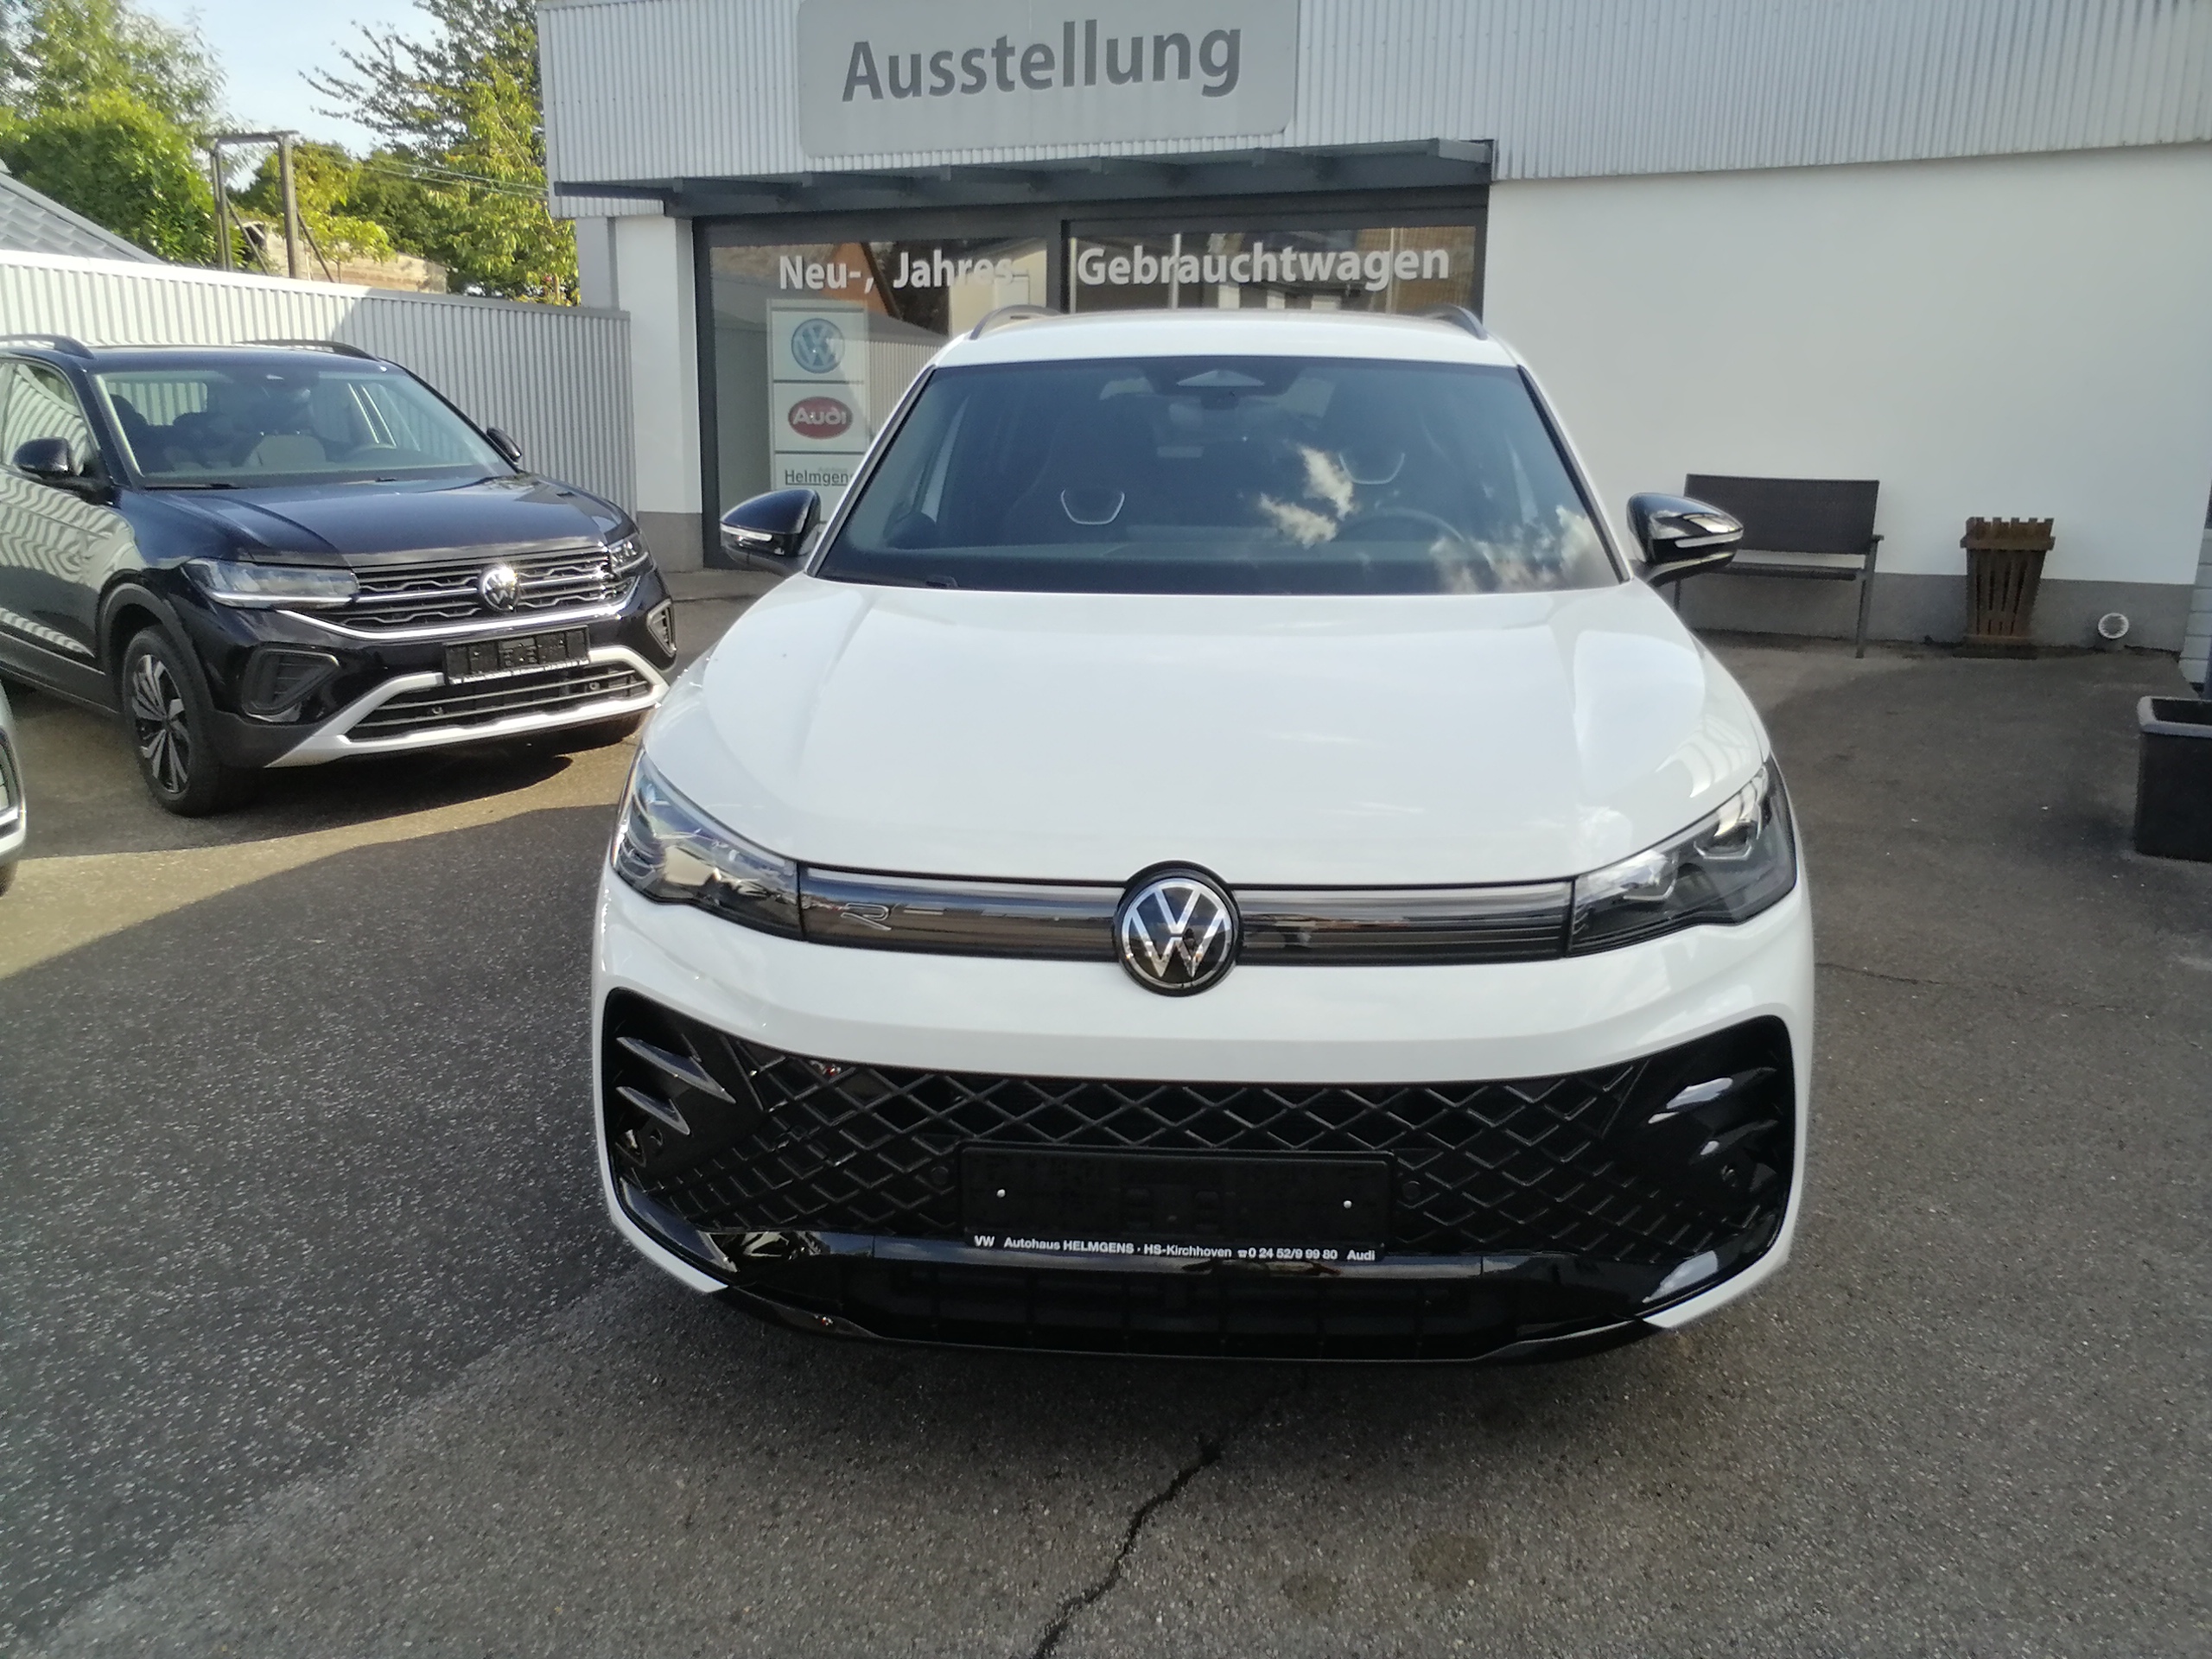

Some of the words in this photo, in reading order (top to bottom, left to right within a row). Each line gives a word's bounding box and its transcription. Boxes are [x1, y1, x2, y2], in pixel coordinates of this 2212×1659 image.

[842, 19, 1242, 102] Ausstellung
[779, 254, 874, 294] Neu-,
[1077, 241, 1450, 291] Gebrauchtwagen
[792, 407, 847, 426] Audi
[785, 469, 855, 486] Helmgen
[974, 1236, 995, 1247] VW
[1003, 1236, 1061, 1250] Autohaus
[1063, 1240, 1135, 1254] HELMGENS
[1143, 1244, 1232, 1258] HS-Kirchhoven
[1259, 1247, 1274, 1259] 24
[1276, 1248, 1303, 1260] 52/9
[1305, 1249, 1320, 1260] 99
[1322, 1249, 1338, 1260] 80
[1346, 1249, 1376, 1262] Audi
